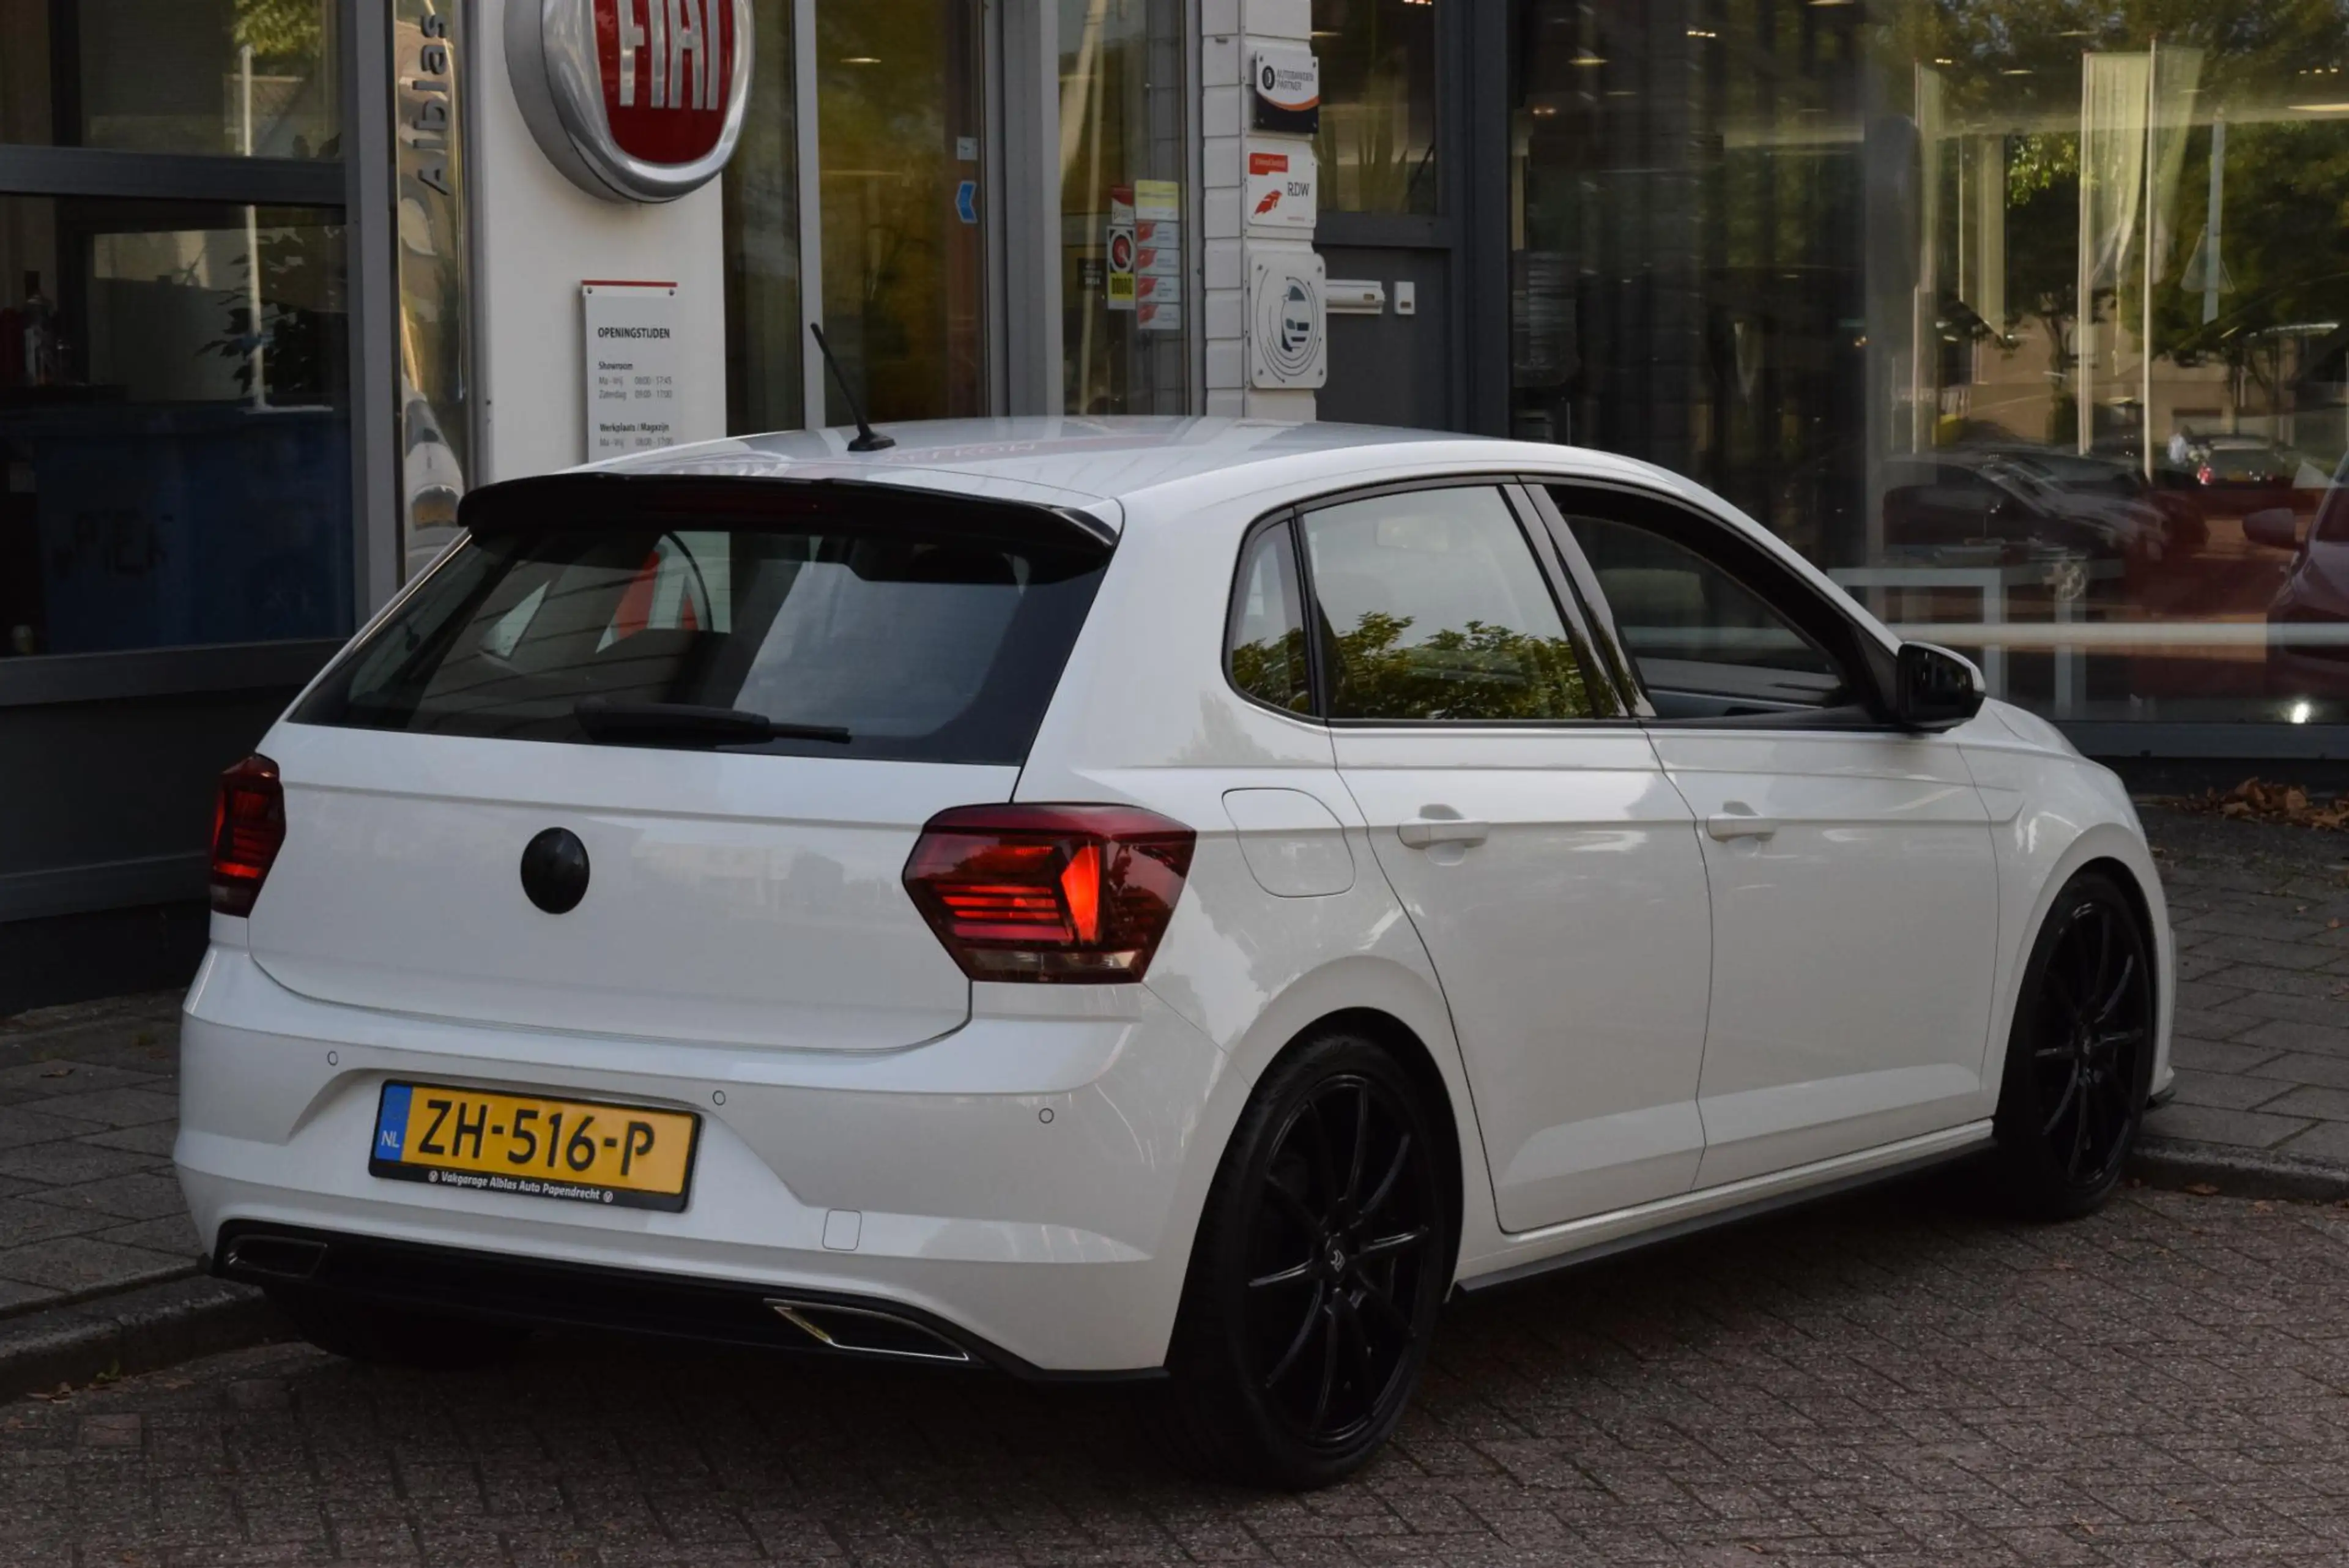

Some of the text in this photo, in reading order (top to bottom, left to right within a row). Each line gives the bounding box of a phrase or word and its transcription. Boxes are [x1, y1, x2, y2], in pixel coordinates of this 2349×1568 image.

[412, 12, 450, 196] Alblas
[1287, 182, 1310, 196] RDW
[598, 327, 670, 338] OPENINGSTIJDEN
[598, 361, 633, 370] Showroom
[599, 423, 636, 434] Werkplaats
[380, 1099, 655, 1176] NL ZH-516-P
[441, 1171, 600, 1200] Vakgarage Alblas Auto Papendrecht
